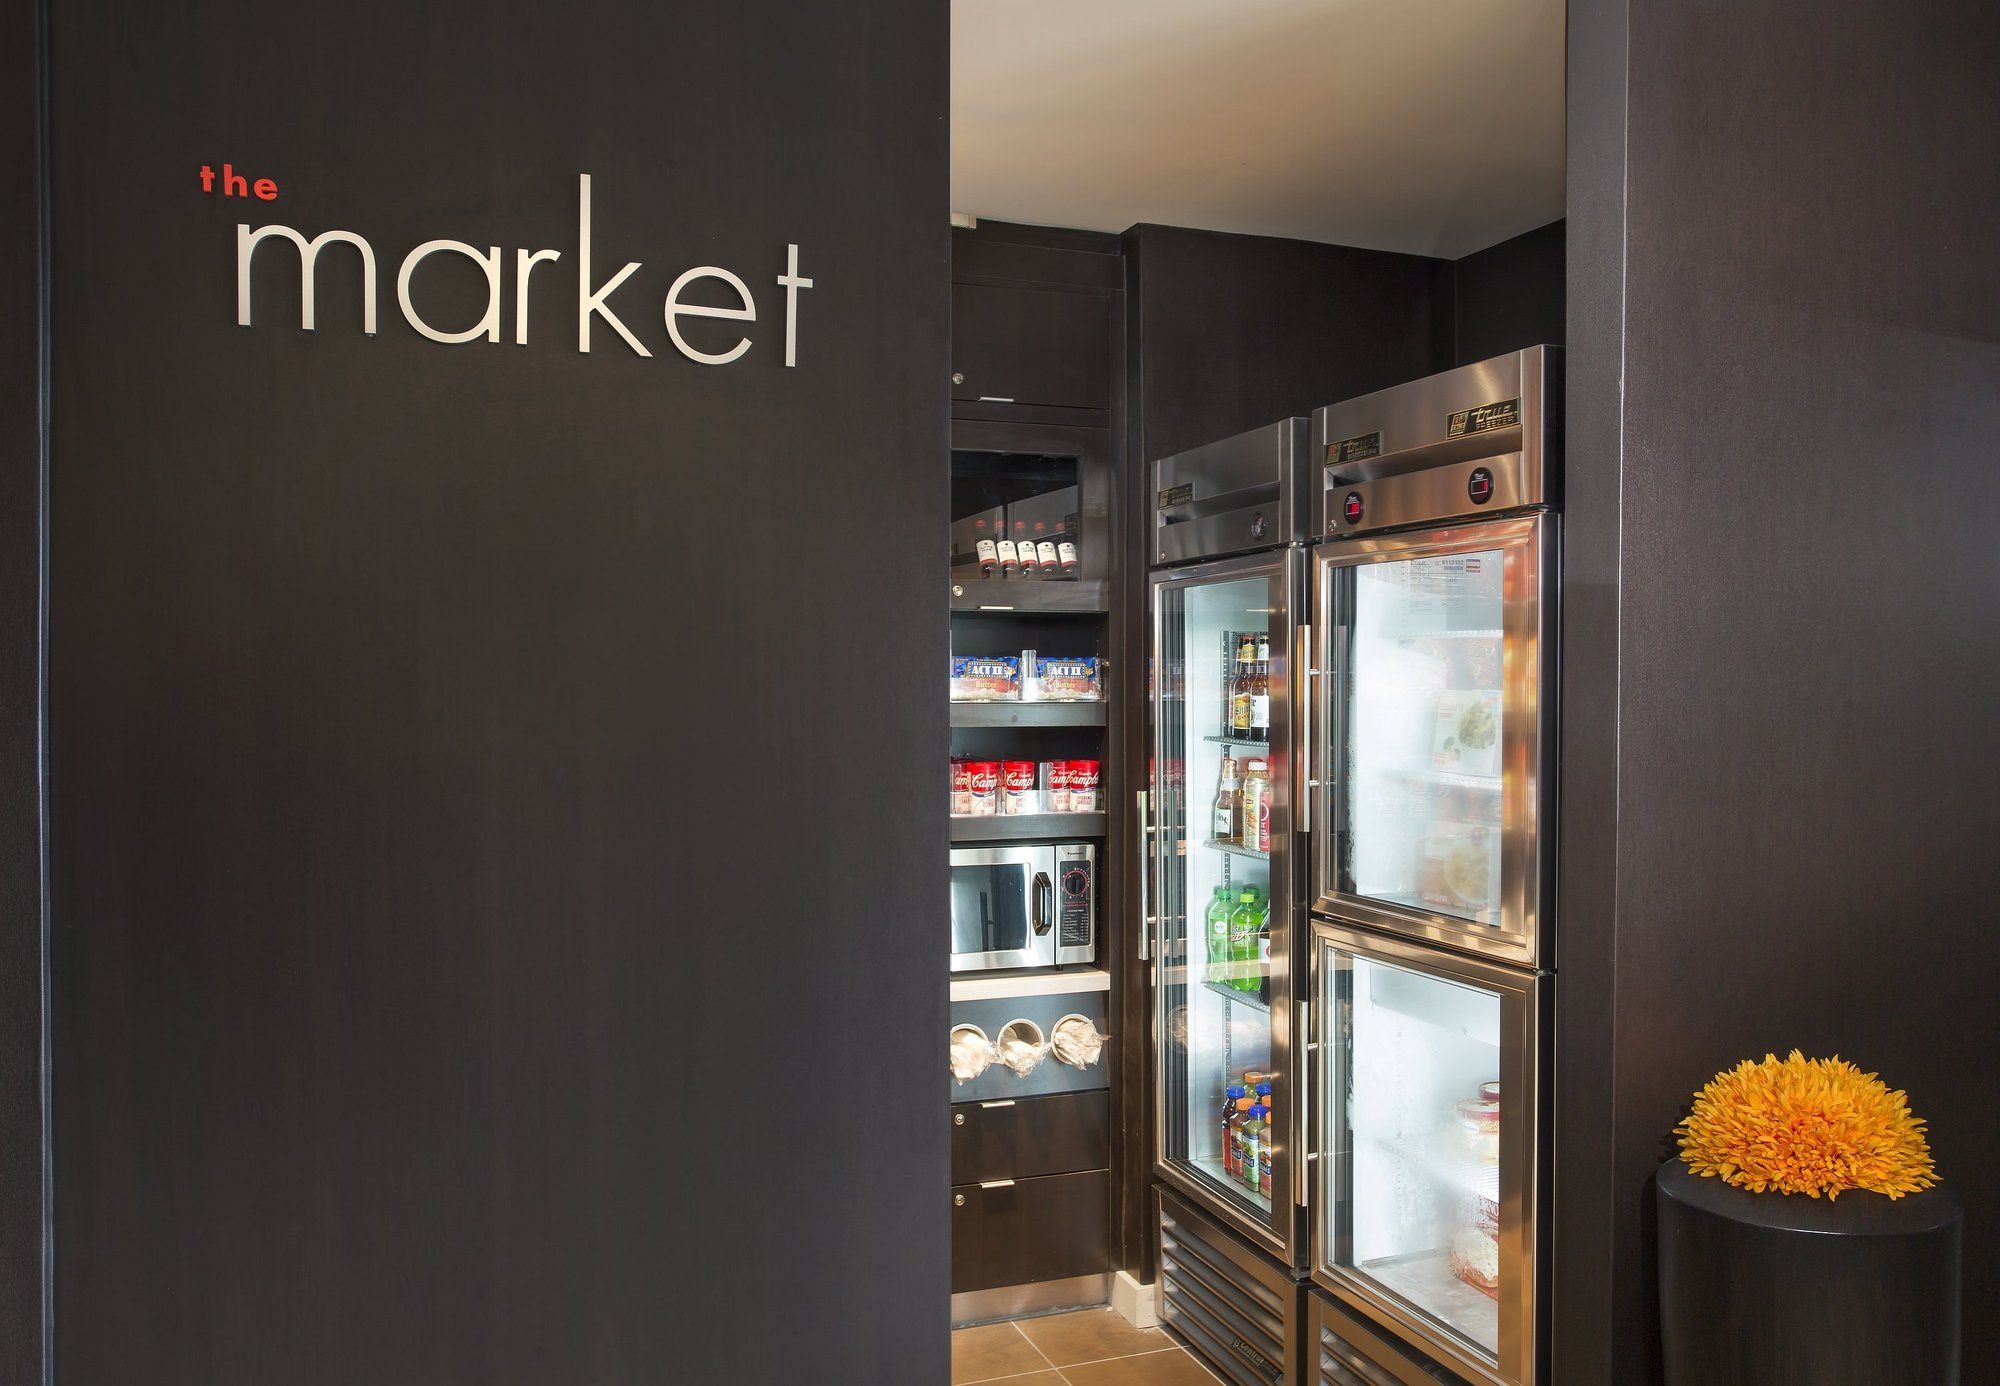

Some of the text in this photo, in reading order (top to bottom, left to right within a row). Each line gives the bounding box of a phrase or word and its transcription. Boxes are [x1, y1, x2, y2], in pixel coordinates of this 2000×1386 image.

[199, 163, 279, 201] the
[237, 173, 814, 368] market
[971, 666, 1003, 676] ACT II
[1050, 666, 1082, 676] ACT II
